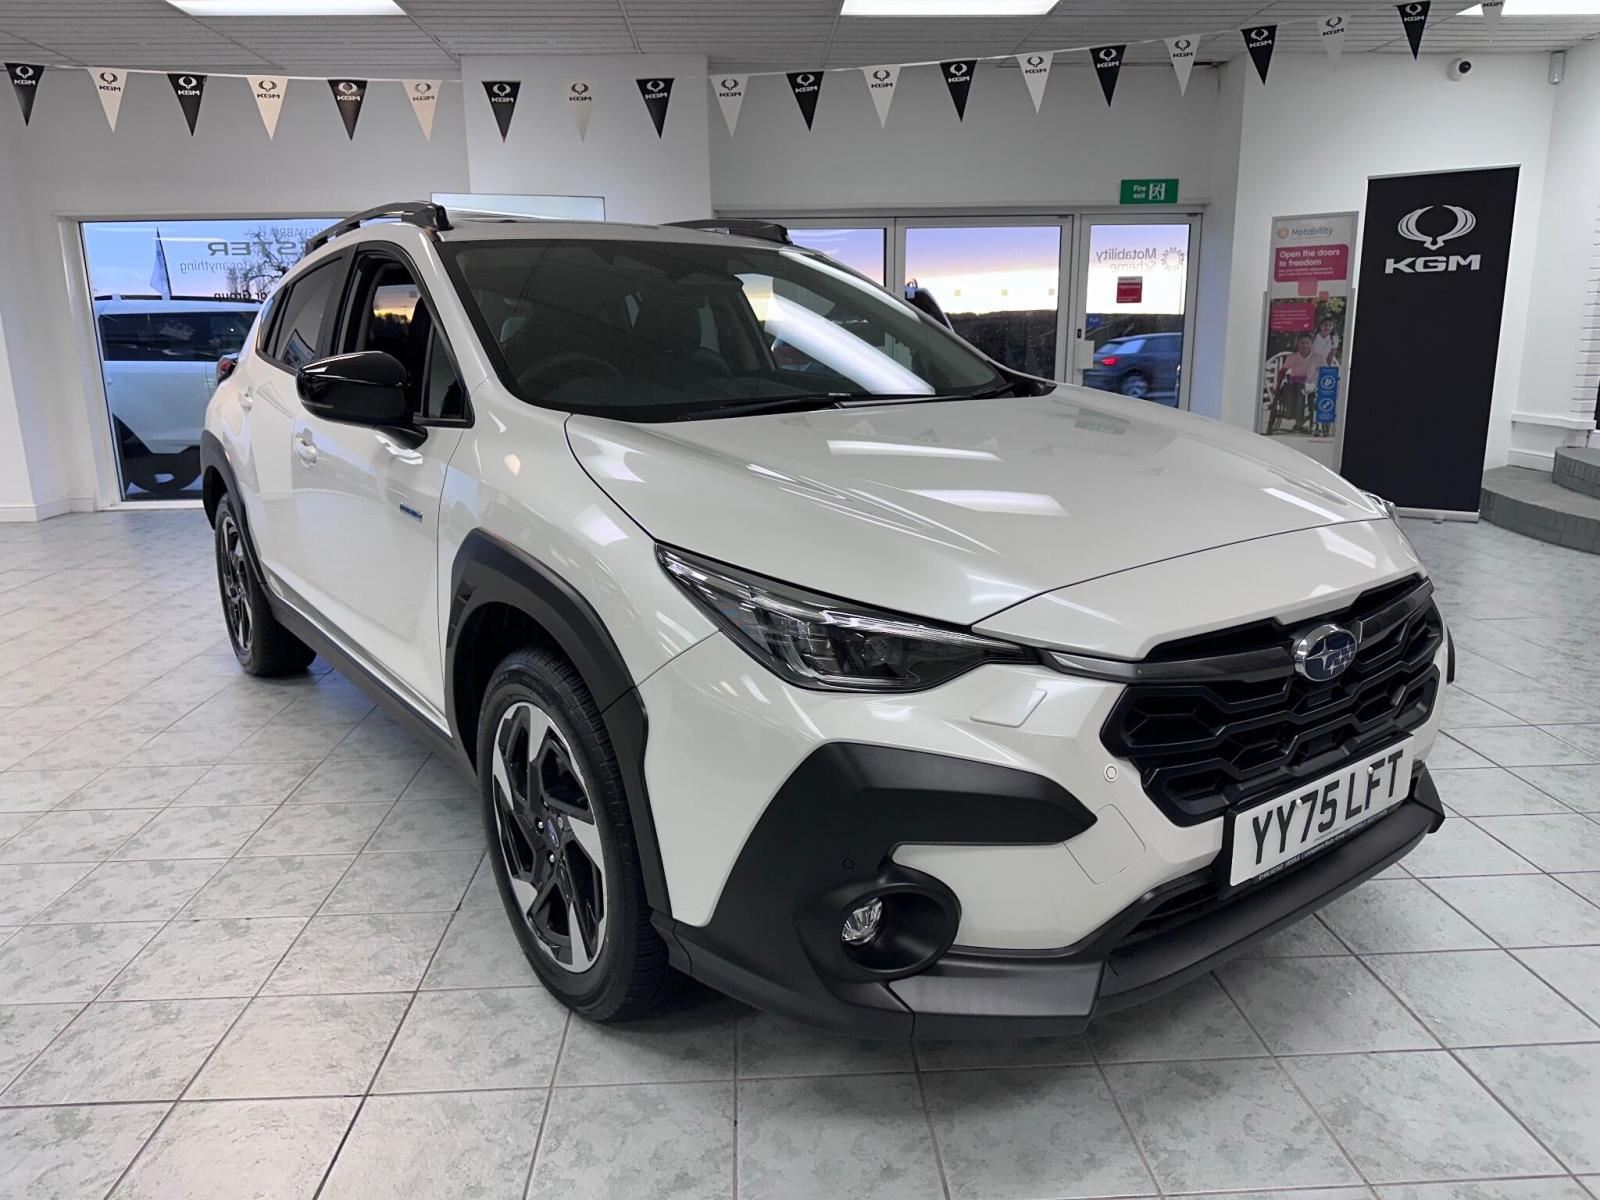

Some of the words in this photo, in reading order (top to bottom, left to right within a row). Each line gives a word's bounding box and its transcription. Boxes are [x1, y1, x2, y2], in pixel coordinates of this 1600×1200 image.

[1404, 14, 1425, 22] KGM
[1322, 27, 1345, 37] KGM
[1249, 38, 1273, 49] KGM
[1097, 60, 1120, 69] KGM
[14, 78, 36, 86] KGM
[948, 75, 970, 83] KGM
[99, 84, 121, 92] KGM
[795, 84, 818, 93] KGM
[177, 89, 200, 97] KGM
[645, 91, 668, 100] KGM
[491, 95, 514, 103] KGM
[1291, 227, 1334, 237] Motability
[1280, 251, 1301, 259] Open
[1303, 249, 1316, 257] the
[1317, 249, 1340, 257] doors
[1289, 258, 1322, 267] freedom
[1385, 254, 1481, 274] KGM
[1252, 779, 1340, 865] YY75
[1345, 749, 1404, 821] LFT
